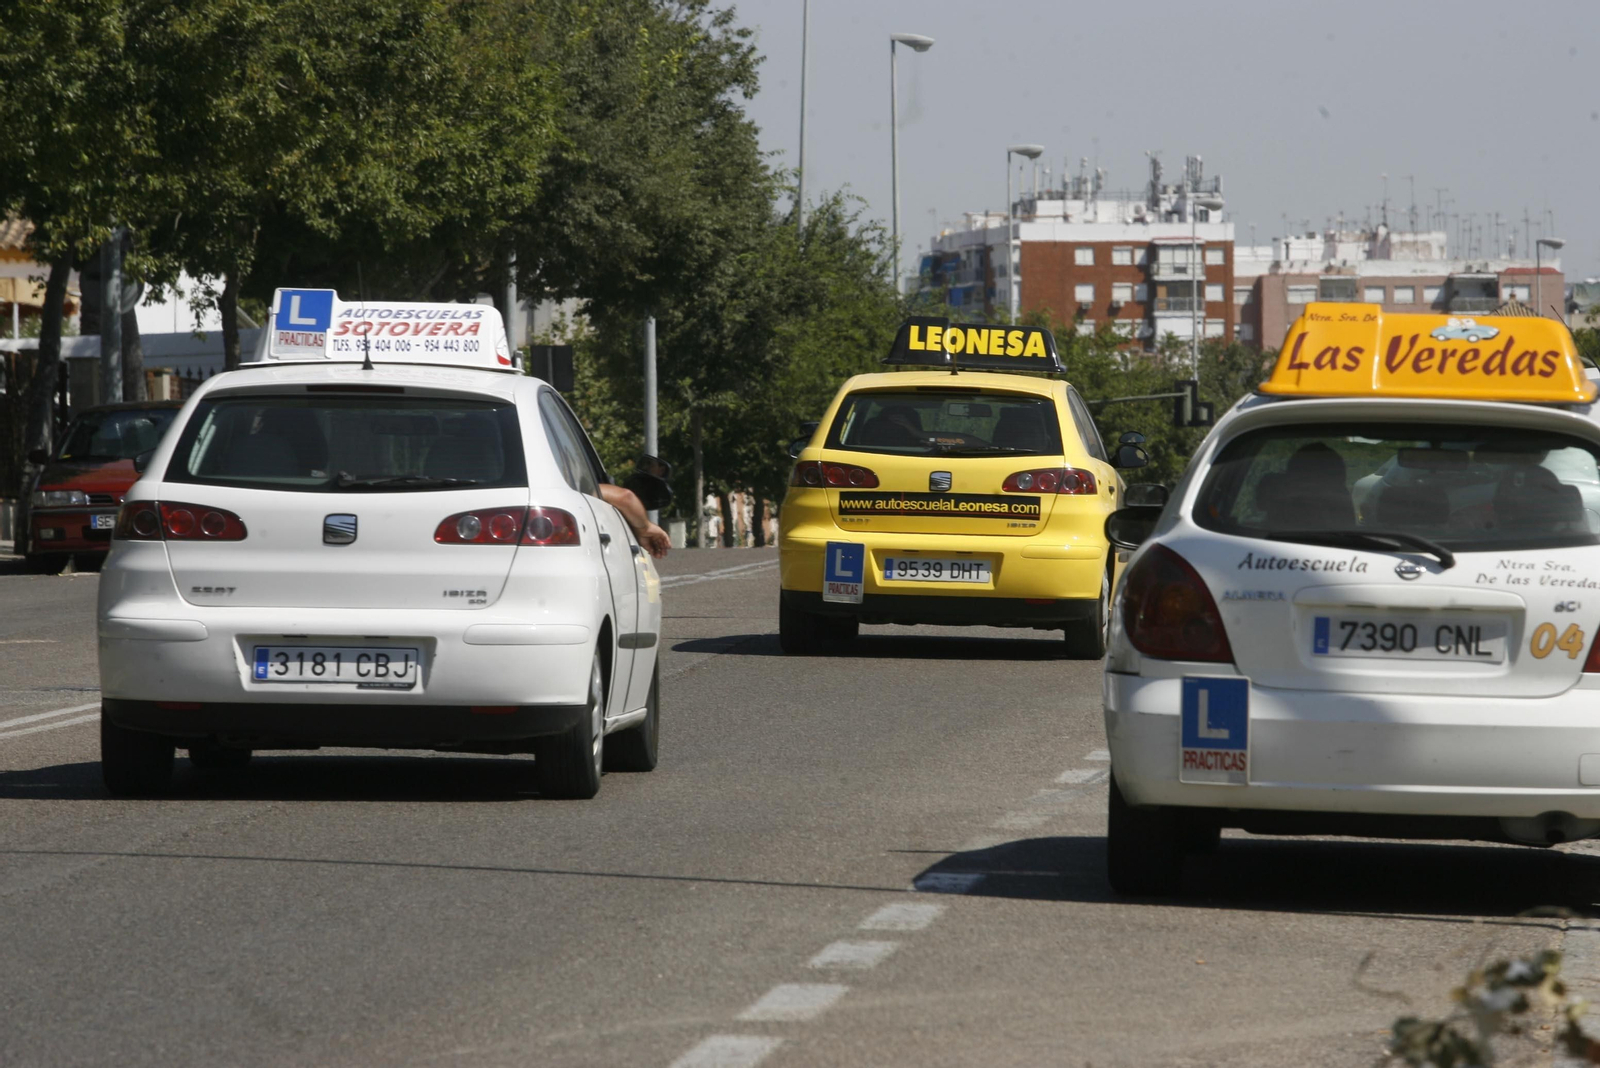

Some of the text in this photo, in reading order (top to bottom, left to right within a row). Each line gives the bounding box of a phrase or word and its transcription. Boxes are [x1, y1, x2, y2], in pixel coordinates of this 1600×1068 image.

[289, 295, 317, 325] L
[338, 308, 484, 320] AUTOESCUELAS
[333, 321, 481, 336] SOTOVERA
[279, 332, 324, 347] PRACTICAS
[333, 339, 352, 351] TLFS.
[356, 339, 371, 351] 954
[375, 339, 391, 352] 404
[395, 339, 411, 352] 006
[424, 340, 439, 352] 954
[444, 340, 459, 352] 443
[463, 340, 479, 352] 800
[909, 325, 1047, 358] LEONESA
[1287, 332, 1561, 378] Las Veredas
[840, 498, 1039, 514] www.autoescuelaLeonesa.com
[97, 515, 111, 527] SE
[835, 549, 853, 577] L
[897, 560, 984, 580] 9539 DHT
[1238, 553, 1368, 574] Autoescuela
[1497, 559, 1577, 573] Ntra Sra.
[1475, 573, 1497, 584] De
[1506, 573, 1530, 585] las
[828, 583, 859, 596] PRACTICAS
[1340, 621, 1492, 656] 7390 CNL
[1530, 622, 1585, 660] 04
[274, 652, 409, 678] 3181 CBJ
[1198, 689, 1230, 739] L
[1183, 750, 1246, 771] PRACTICAS
